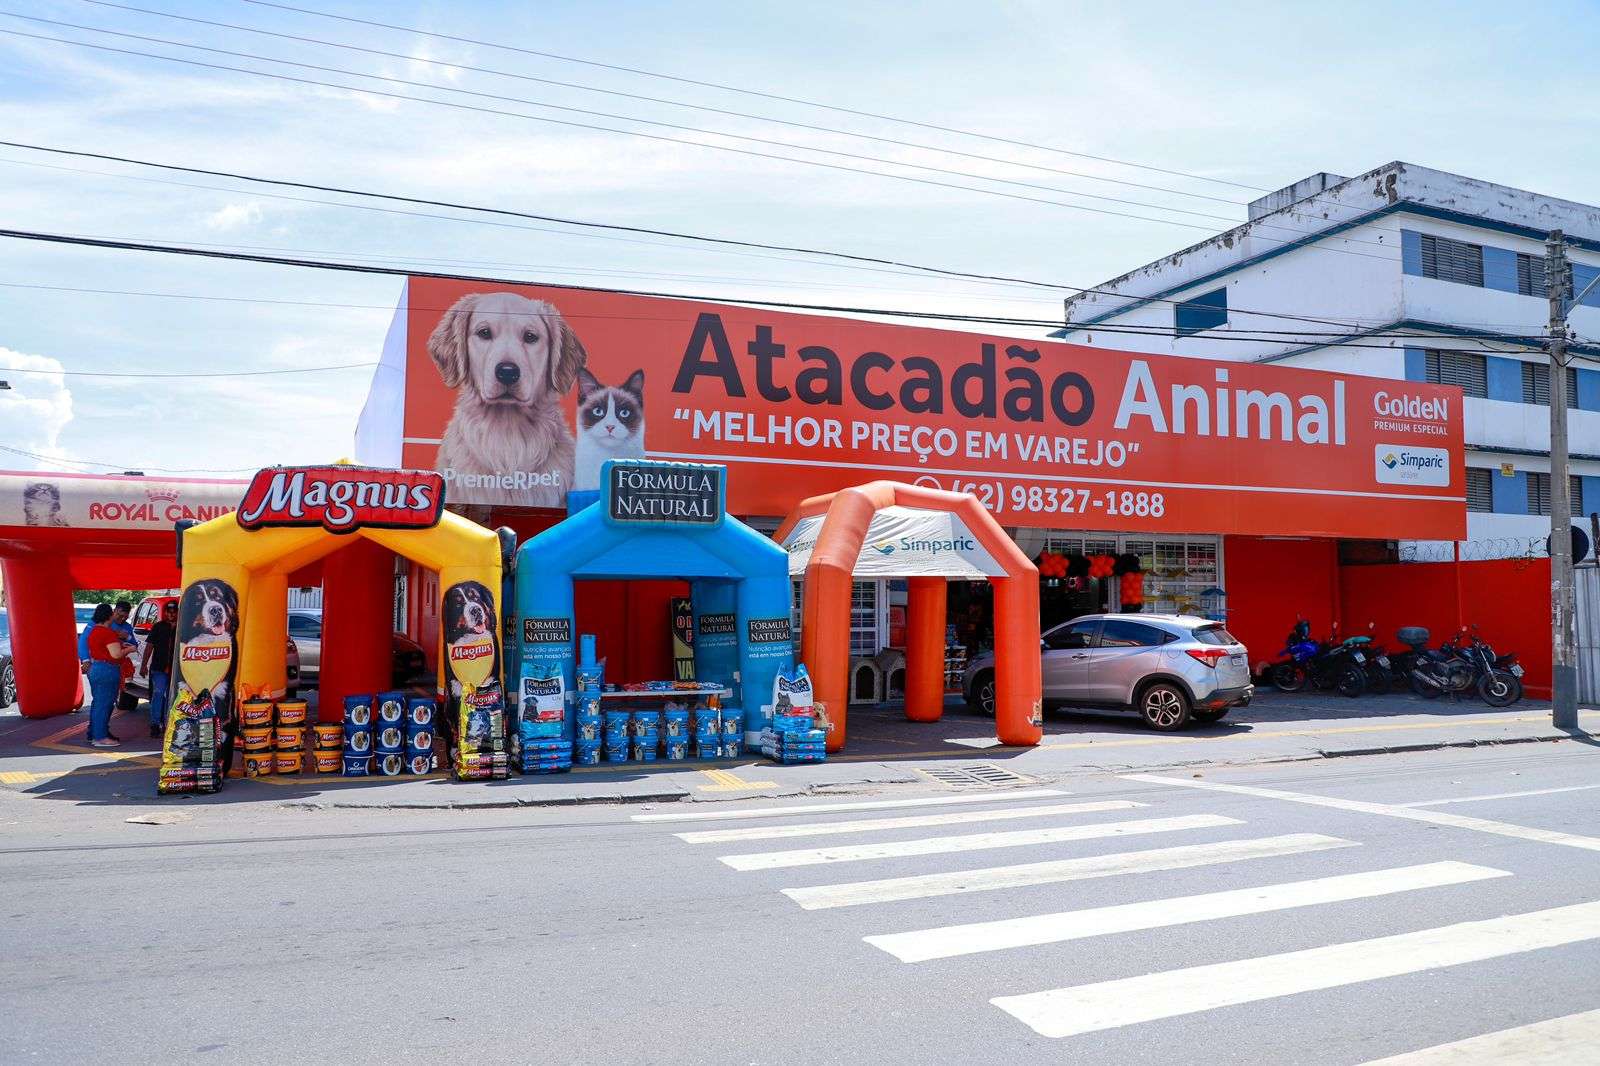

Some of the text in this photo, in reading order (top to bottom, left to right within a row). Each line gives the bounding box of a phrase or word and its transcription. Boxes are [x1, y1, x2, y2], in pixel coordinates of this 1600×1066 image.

[671, 312, 1346, 446] Atacadão Animal
[1374, 391, 1448, 420] GoldeN
[1374, 420, 1448, 436] PREMIUM ESPECIAL
[852, 421, 958, 464] PREÇO
[966, 430, 1008, 460] EM
[1400, 452, 1443, 470] Simparic
[617, 469, 713, 492] FÓRMULA
[243, 472, 432, 525] Magnus
[617, 496, 713, 517] NATURAL
[1011, 485, 1165, 518] 98327-1888
[89, 502, 160, 521] ROYAL
[900, 536, 975, 555] Simparic
[525, 619, 569, 630] FÓRMULA
[525, 631, 570, 641] NATURAL
[751, 630, 791, 641] NATURAL
[183, 647, 229, 661] Magnus
[452, 645, 491, 660] Magnus
